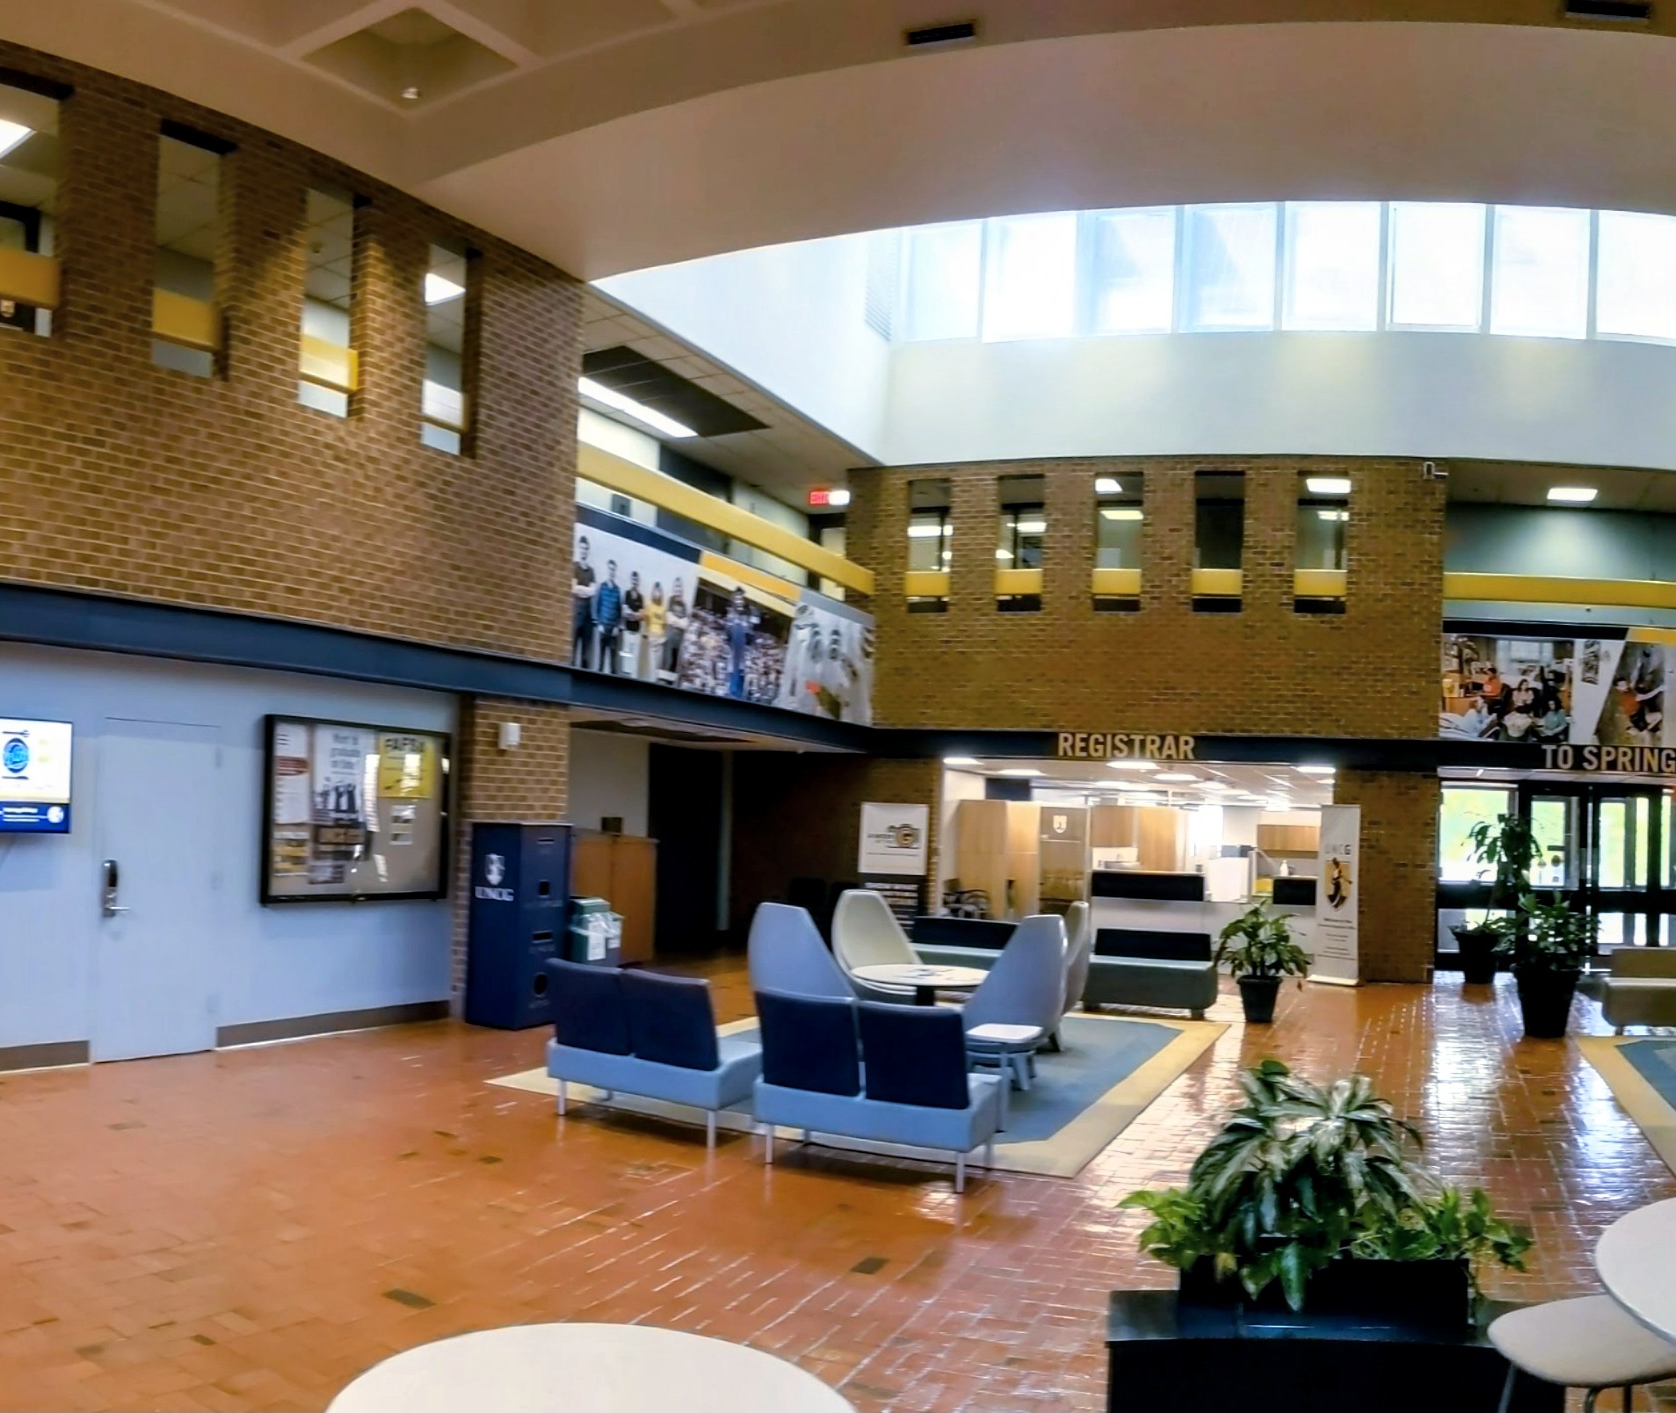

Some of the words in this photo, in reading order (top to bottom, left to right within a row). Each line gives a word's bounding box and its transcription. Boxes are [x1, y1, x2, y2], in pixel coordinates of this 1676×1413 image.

[1057, 732, 1196, 760] REGISTRAR
[1542, 744, 1574, 769] TO
[1582, 747, 1676, 774] SPRING
[475, 886, 515, 902] UNCG
